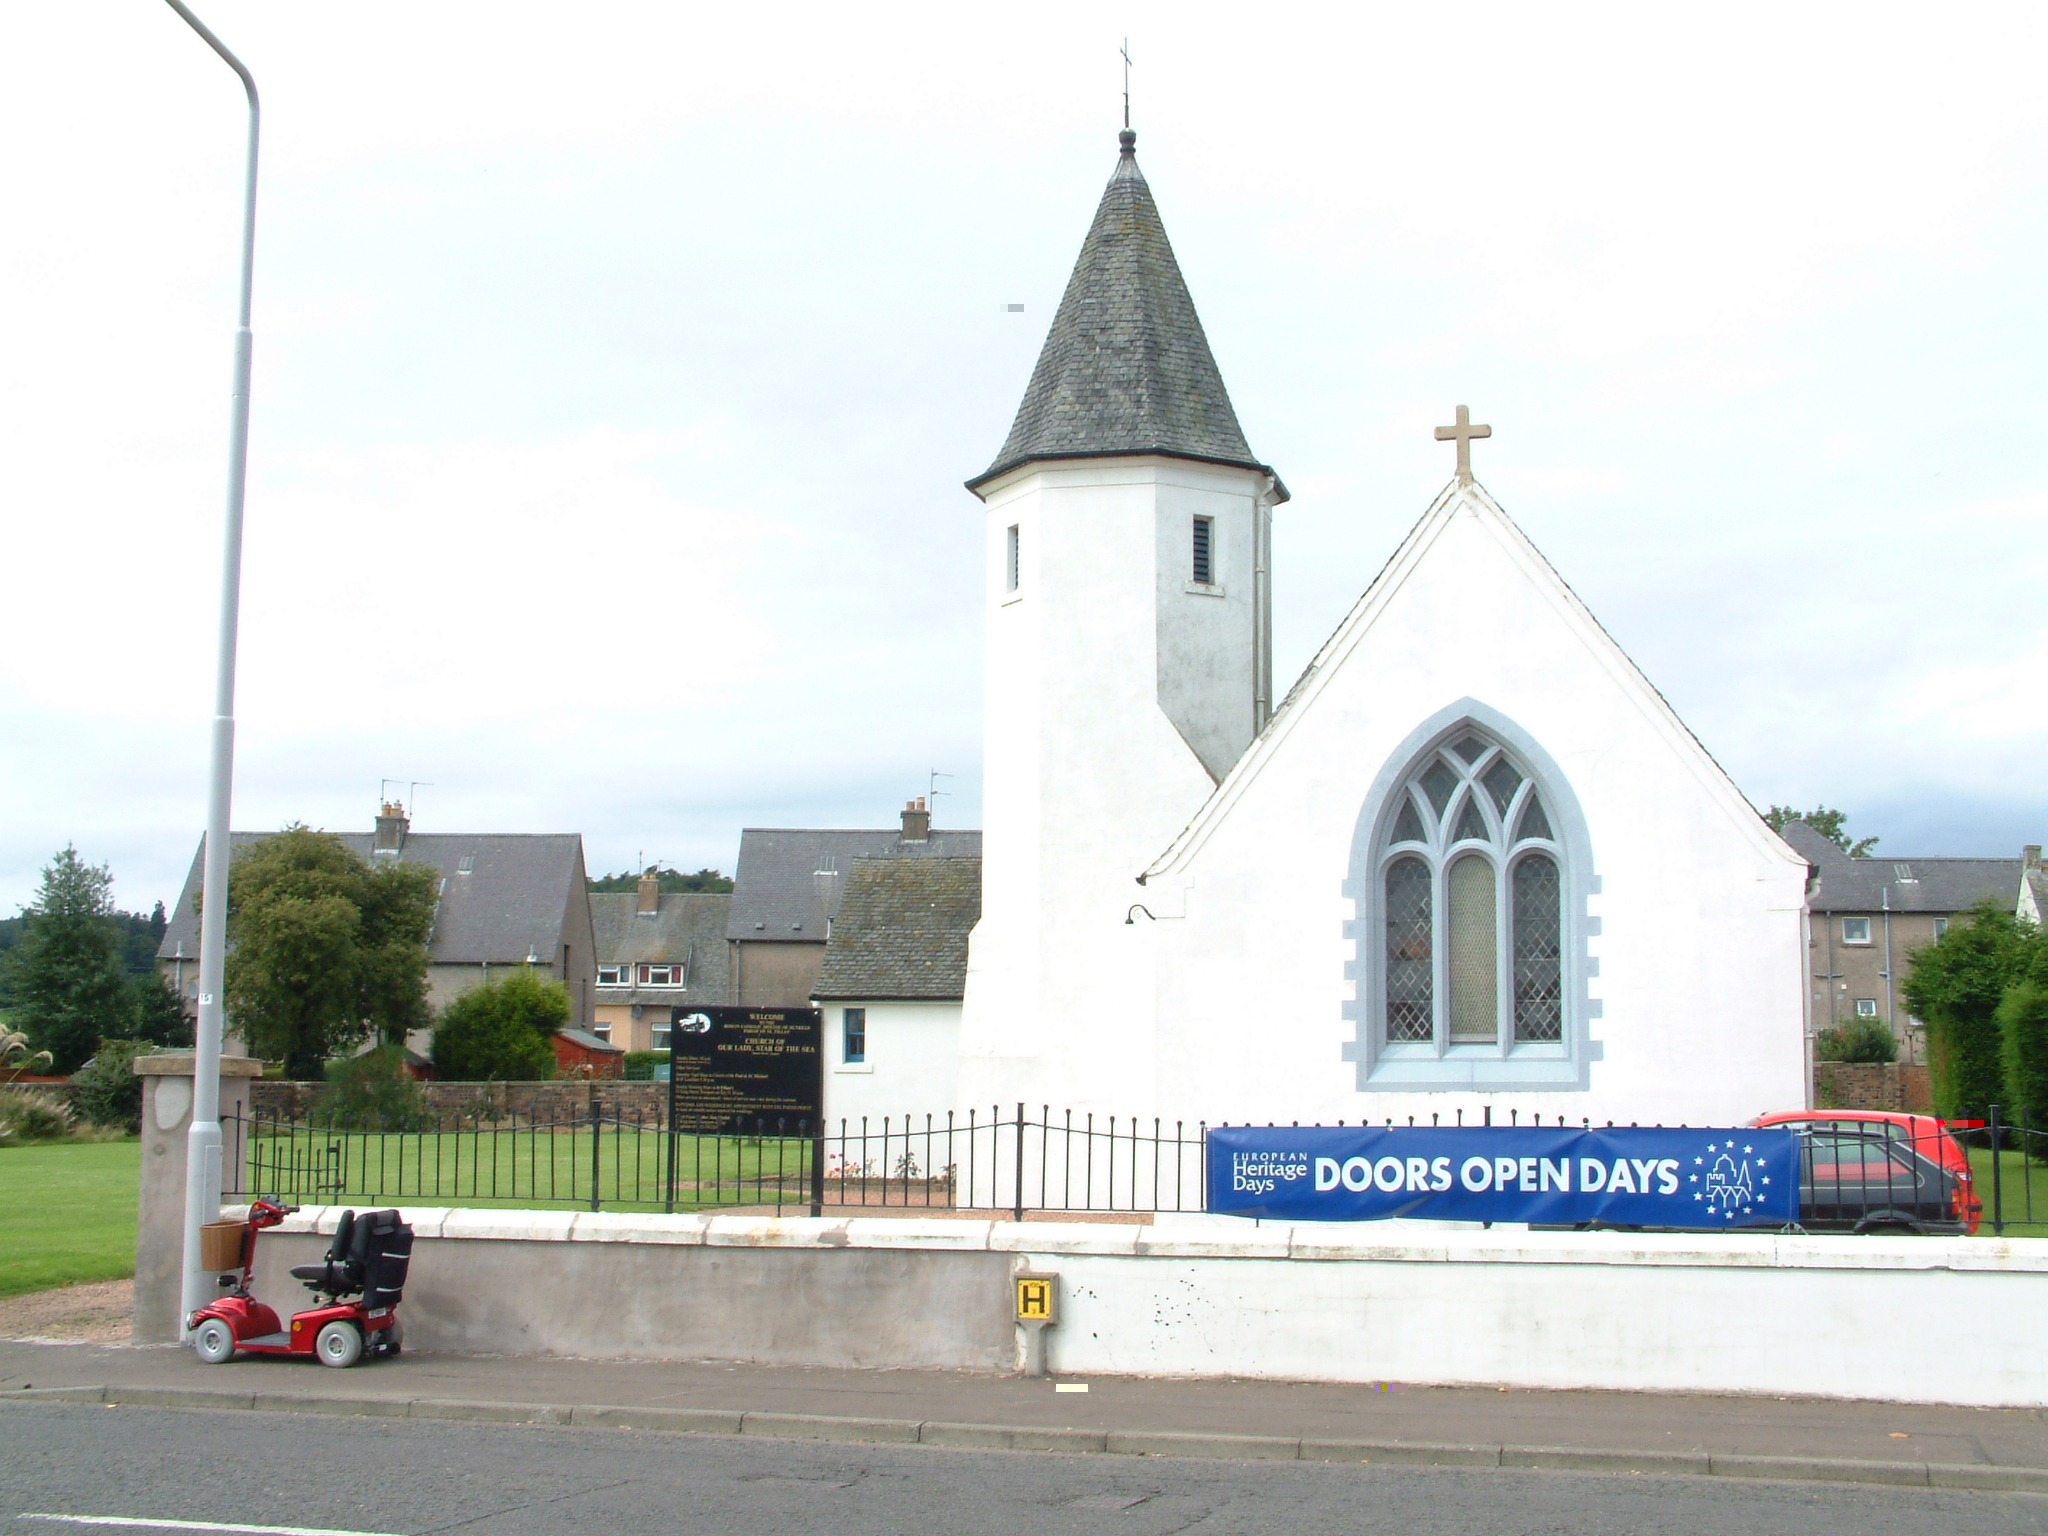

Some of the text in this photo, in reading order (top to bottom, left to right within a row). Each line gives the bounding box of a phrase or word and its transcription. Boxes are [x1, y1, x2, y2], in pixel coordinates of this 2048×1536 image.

[749, 1013, 785, 1021] WELCOME
[745, 1037, 775, 1045] CHURCH
[755, 1044, 773, 1052] STAR
[786, 1045, 799, 1053] THE
[1233, 1152, 1308, 1162] EUROPEAN
[1233, 1160, 1308, 1181] Heritage
[1314, 1156, 1680, 1195] DOORS OPEN DAYS
[1233, 1175, 1275, 1196] Days
[1023, 1284, 1045, 1313] H
